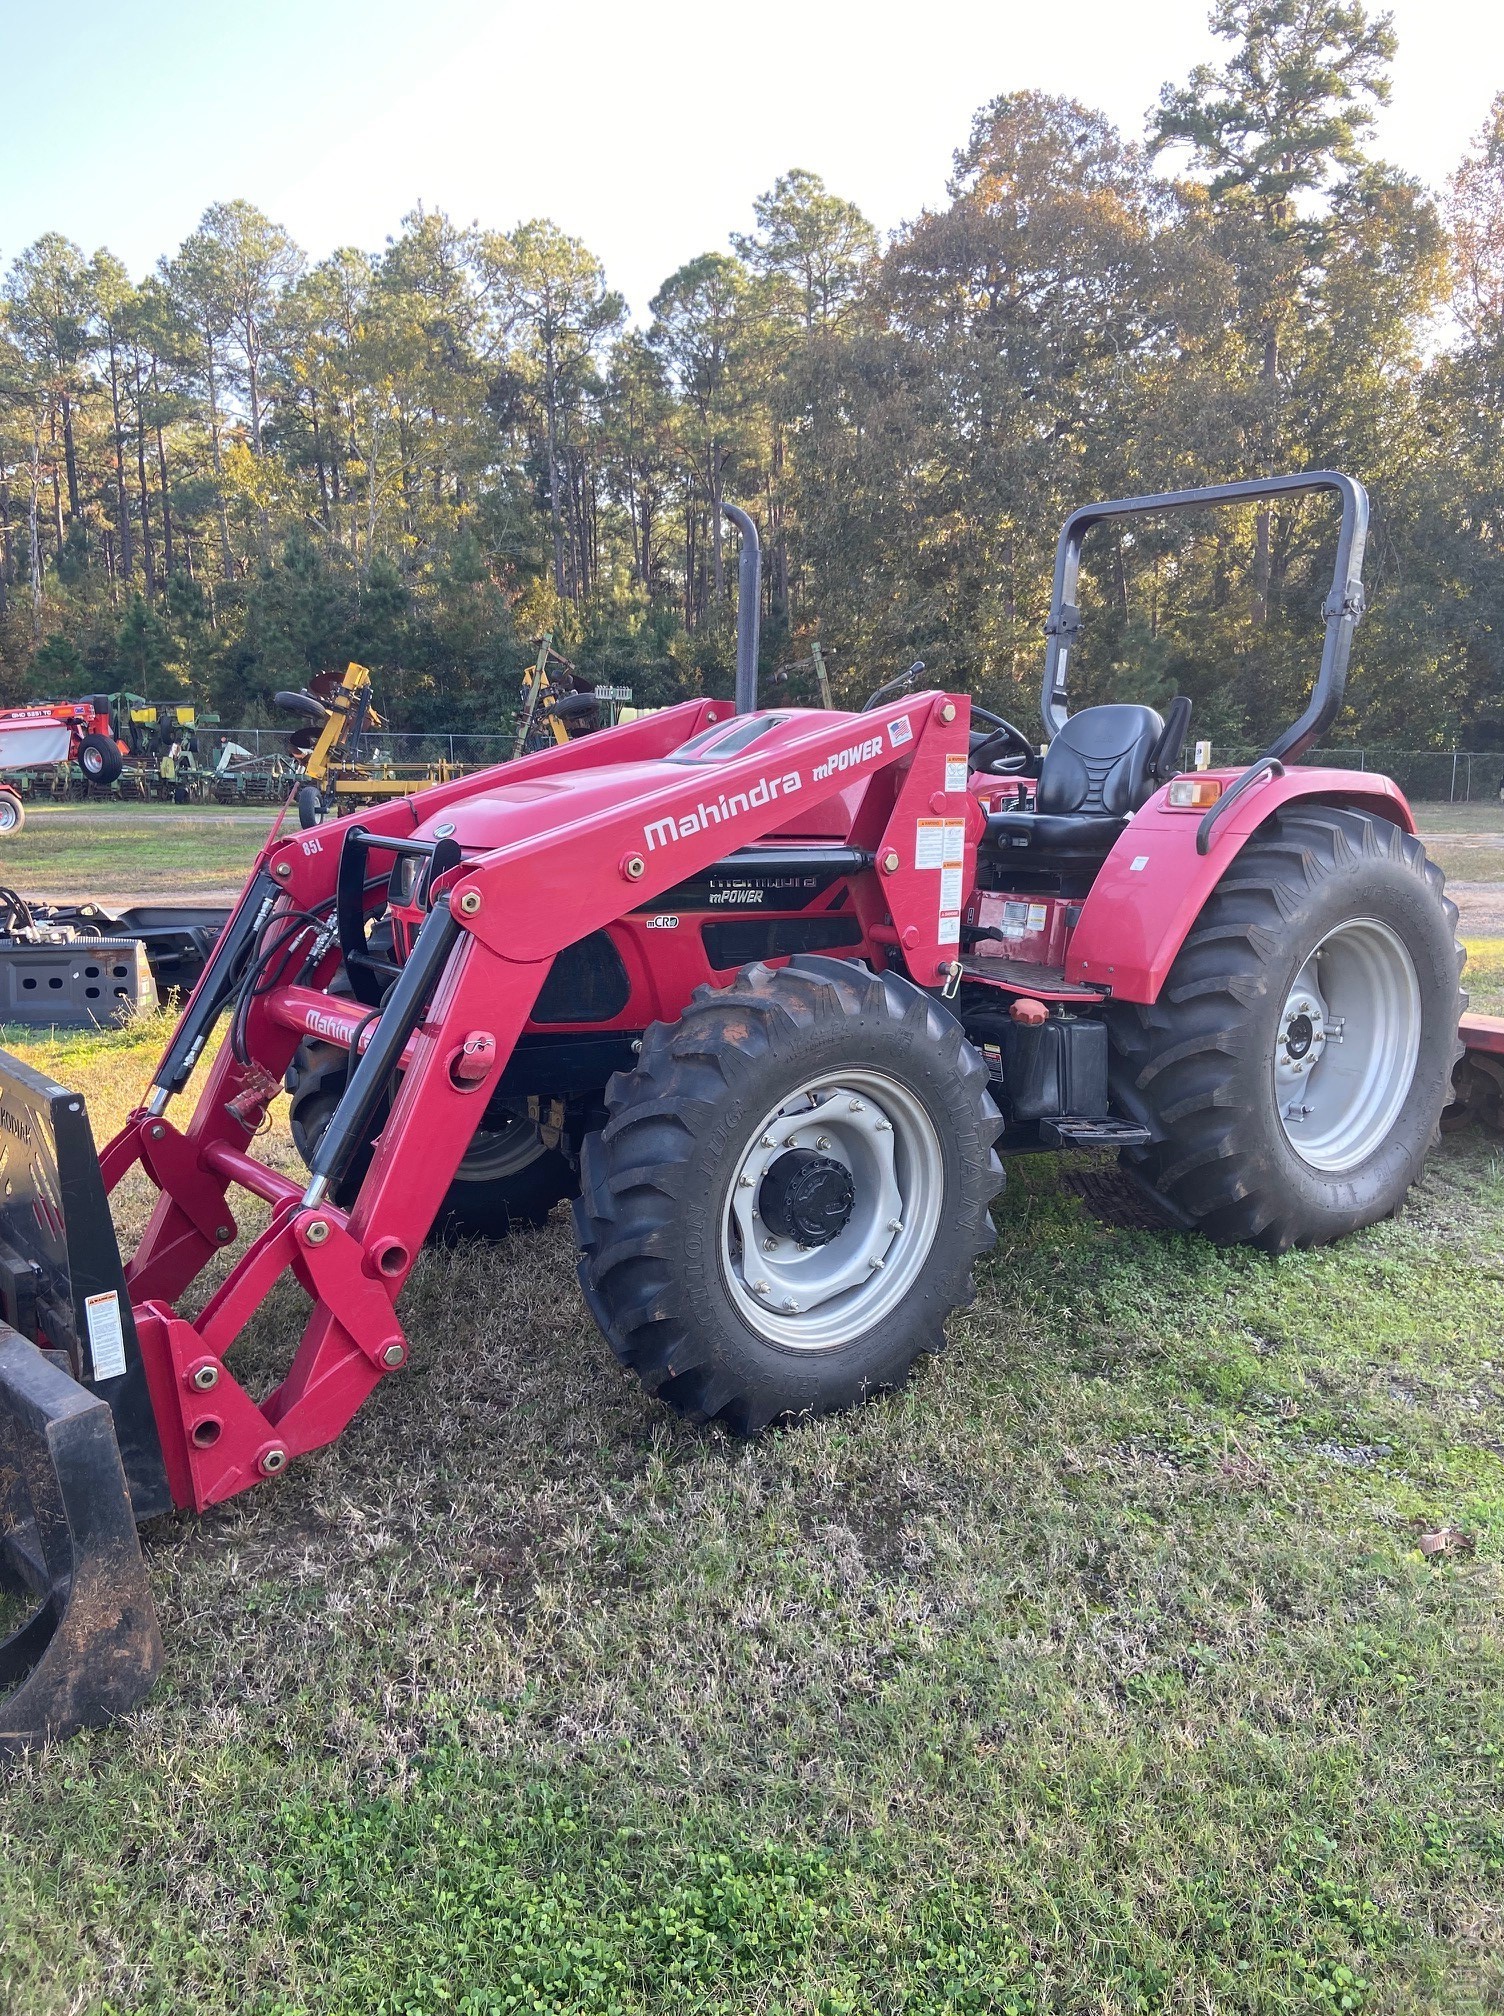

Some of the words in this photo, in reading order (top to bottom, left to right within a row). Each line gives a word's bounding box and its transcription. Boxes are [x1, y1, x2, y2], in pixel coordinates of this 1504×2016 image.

[812, 736, 884, 782] mPOWER
[643, 771, 803, 851] Mahindra
[302, 839, 324, 857] 85L
[709, 889, 764, 904] mPOWER
[0, 1106, 32, 1147] KODIAK
[698, 1104, 745, 1178] LUG
[933, 1064, 985, 1232] TITAN
